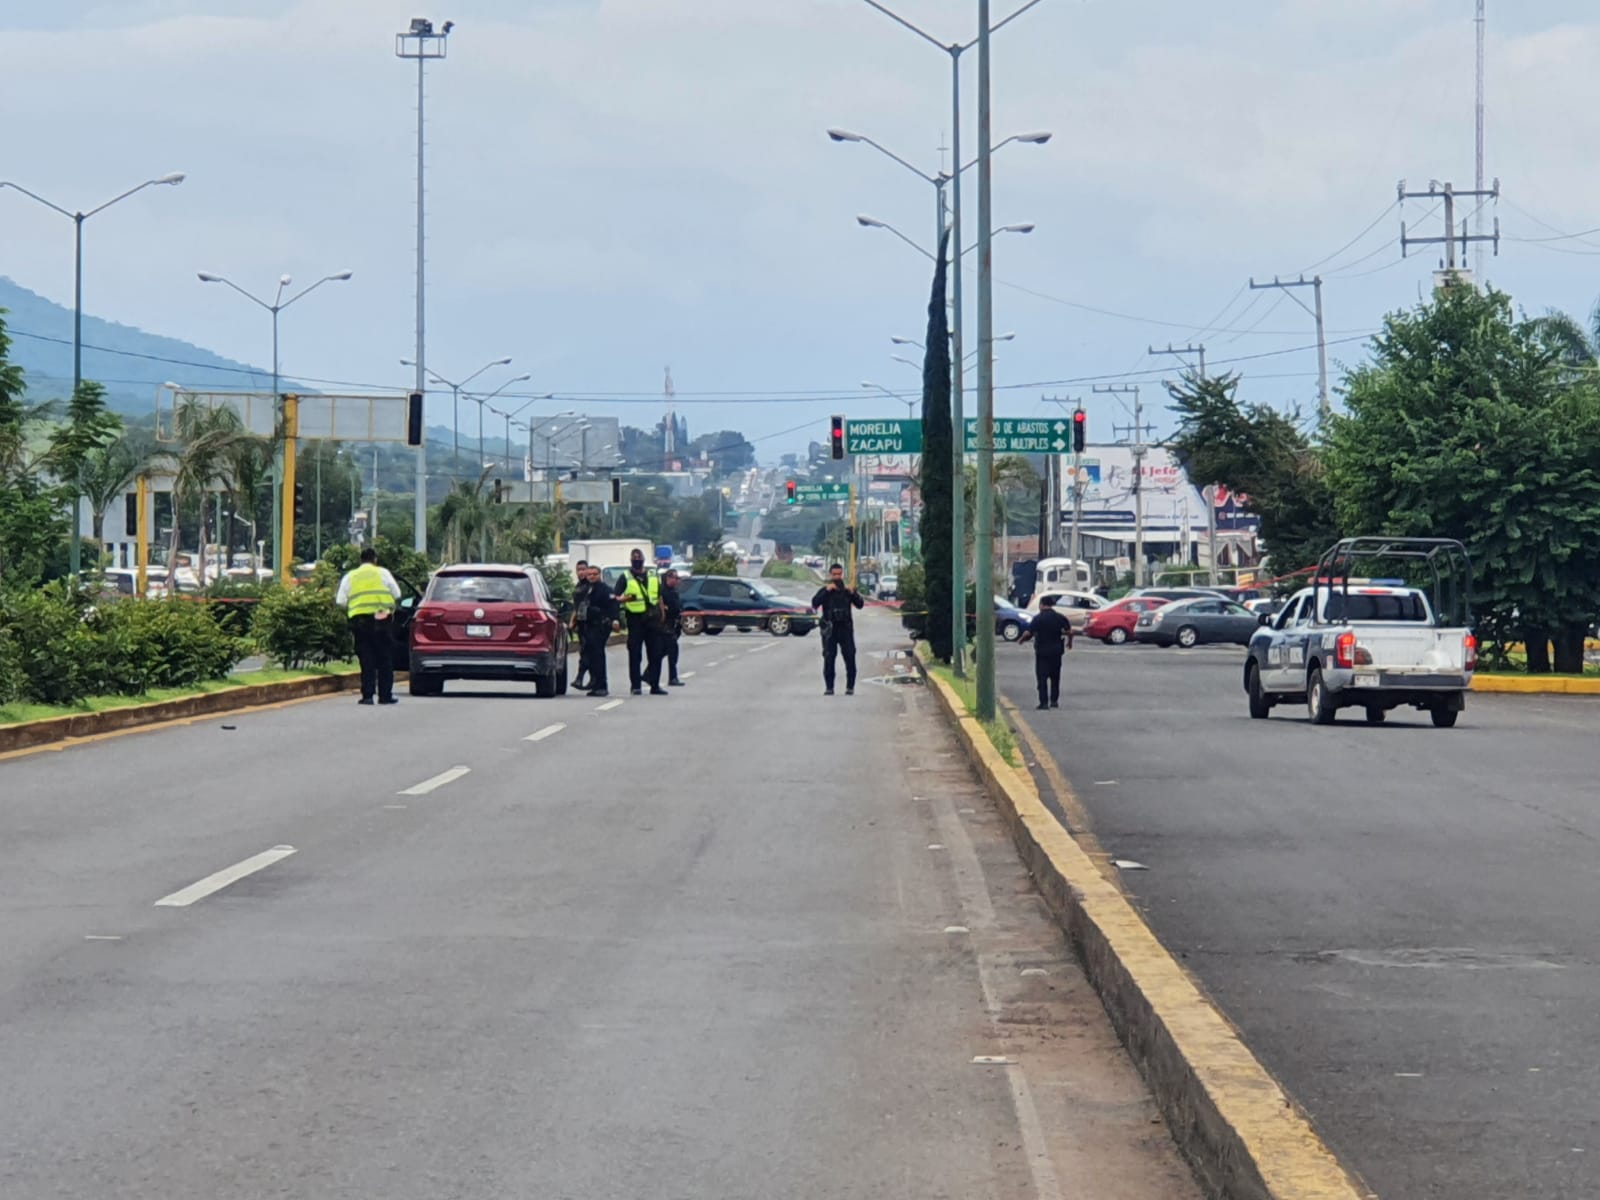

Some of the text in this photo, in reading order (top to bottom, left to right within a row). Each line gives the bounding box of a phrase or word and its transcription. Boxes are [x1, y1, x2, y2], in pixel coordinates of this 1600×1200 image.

[849, 422, 902, 436] MORELIA
[1003, 422, 1013, 434] DE
[1017, 422, 1049, 434] ABASTOS
[850, 438, 903, 451] ZACAPU
[1010, 437, 1049, 450] MULTIPLES
